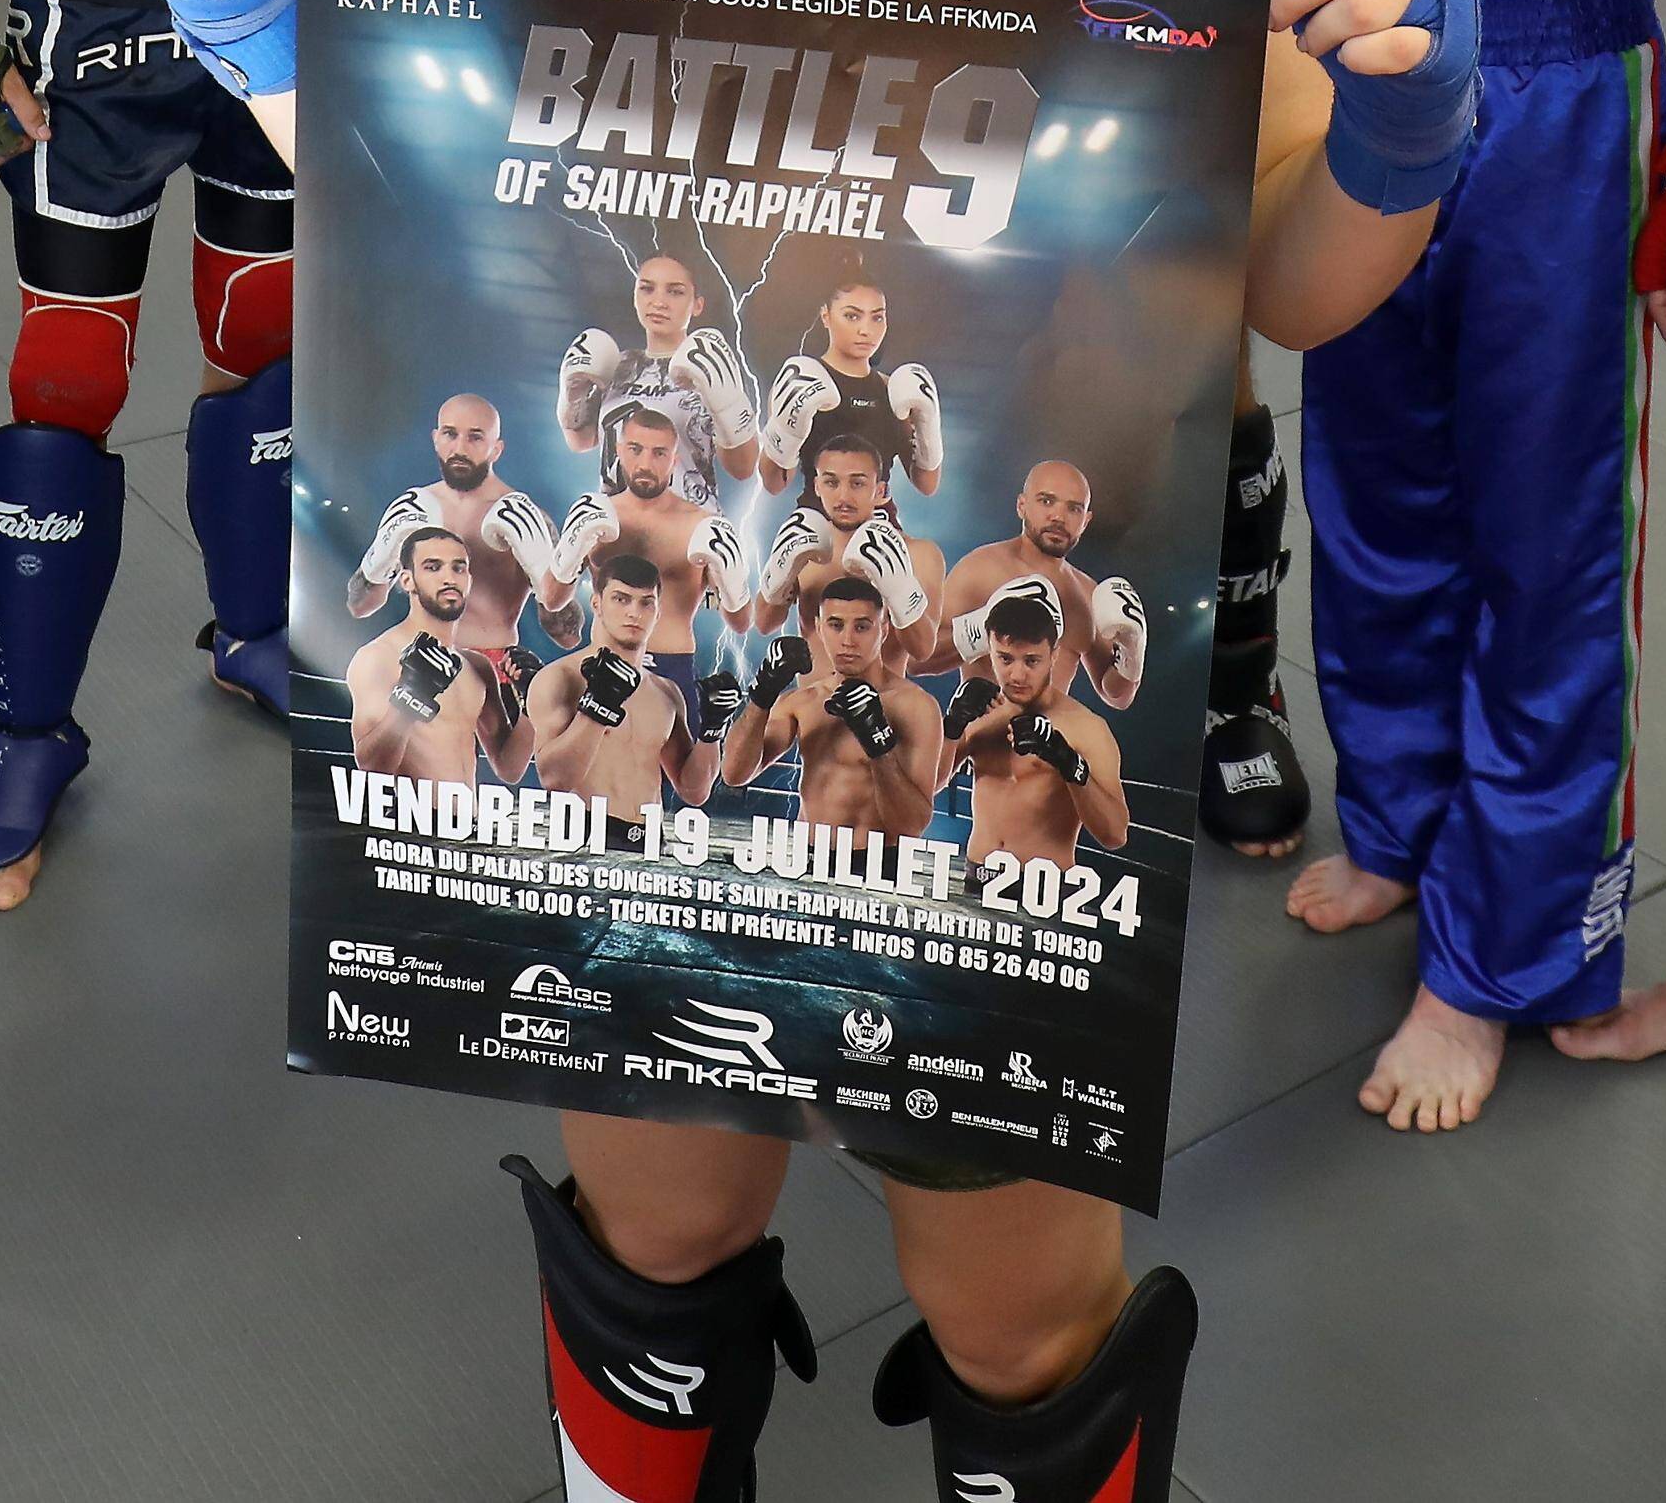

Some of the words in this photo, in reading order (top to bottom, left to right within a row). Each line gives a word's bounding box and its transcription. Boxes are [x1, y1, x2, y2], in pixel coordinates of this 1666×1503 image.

[905, 2, 933, 24] LA
[940, 6, 1037, 34] FFKMDA
[77, 31, 196, 80] RIN
[508, 24, 919, 180] BATTLE
[903, 63, 1041, 250] 9
[494, 157, 551, 205] OF
[564, 164, 886, 240] SAINT-RAPHAËL
[330, 765, 608, 857] VENDREDI
[639, 803, 710, 868] 19
[733, 815, 960, 902] JUILLET
[981, 850, 1142, 938] 2024
[364, 837, 435, 868] AGORA
[439, 847, 467, 873] DU
[471, 851, 544, 885] PALAIS
[548, 862, 588, 889] DES
[593, 868, 693, 900] CONGRES
[697, 879, 723, 903] DE
[728, 882, 890, 928] SAINT-RAPHAËL
[893, 902, 910, 930] À
[913, 910, 991, 943] PARTIR
[996, 923, 1023, 949] DE
[1031, 929, 1103, 965] 19H30
[375, 866, 432, 894] TARIF
[435, 876, 512, 909] UNIQUE
[514, 889, 573, 918] 10,00
[576, 897, 592, 920] €
[609, 898, 697, 930] TICKETS
[700, 909, 727, 934] EN
[731, 912, 836, 949] PRÉVENTE
[852, 928, 915, 960] INFOS
[924, 939, 953, 966] 06
[958, 947, 988, 972] 85
[992, 953, 1022, 978] 26
[1025, 958, 1055, 984] 49
[1059, 965, 1090, 992] 06
[328, 940, 395, 966] CNS
[328, 962, 411, 985] Nettoyage
[416, 971, 485, 993] Industriel
[327, 990, 411, 1037] New
[328, 1031, 411, 1048] promotion
[907, 1053, 984, 1078] andélim
[1001, 1072, 1048, 1090] RIVIERA
[836, 1086, 891, 1104] MASCHERPA
[1077, 1092, 1125, 1113] WALKER
